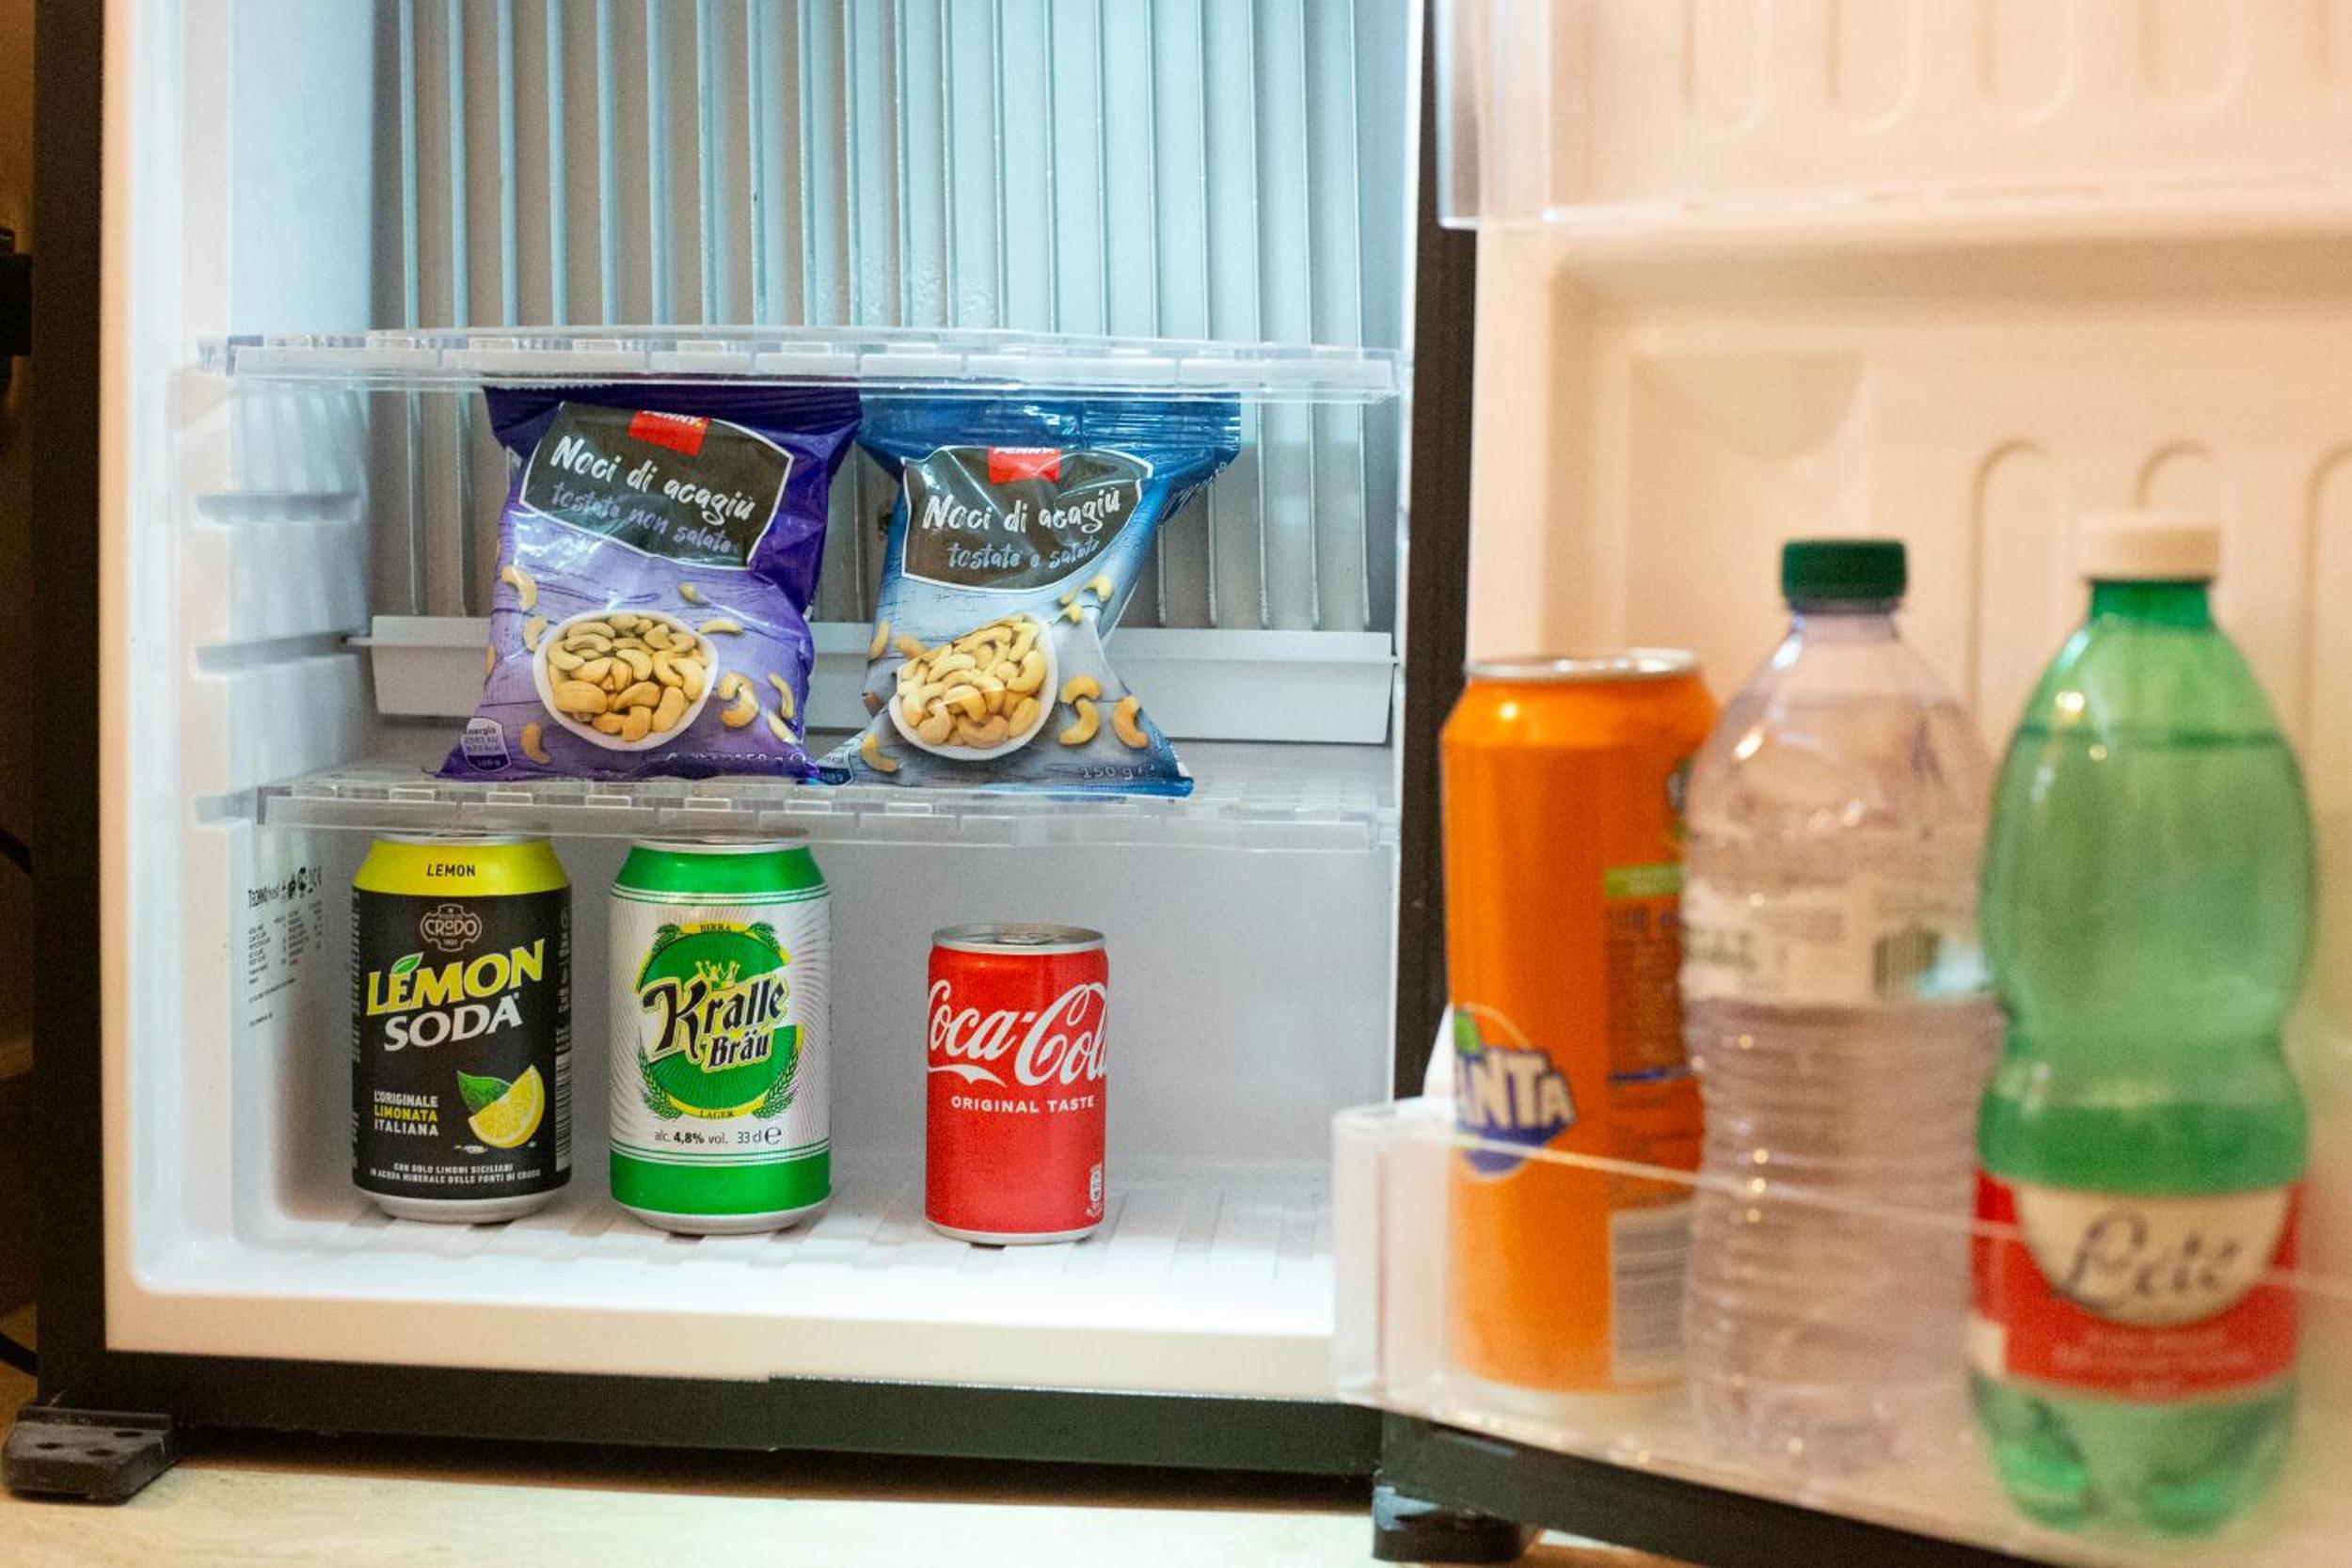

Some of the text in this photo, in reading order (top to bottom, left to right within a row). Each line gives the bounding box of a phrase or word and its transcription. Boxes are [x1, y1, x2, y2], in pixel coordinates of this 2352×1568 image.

[549, 436, 622, 483] Noci
[626, 459, 659, 493] di
[551, 482, 621, 518] tostate
[628, 508, 670, 535] non
[922, 494, 993, 530] Noci
[1003, 499, 1028, 533] di
[947, 542, 1022, 570] tostate
[426, 863, 477, 877] LEMON
[424, 919, 478, 937] CRODO
[367, 939, 546, 1016] LEMON
[384, 994, 523, 1052] SODA
[643, 975, 787, 1060] Kralle
[707, 1030, 771, 1070] Bräu
[374, 1104, 438, 1123] LIMONATA
[951, 1095, 1095, 1113] ORIGINAL TASTE
[374, 1117, 439, 1137] ITALIANA
[673, 1132, 705, 1145] 4,8%
[707, 1132, 728, 1145] vol.
